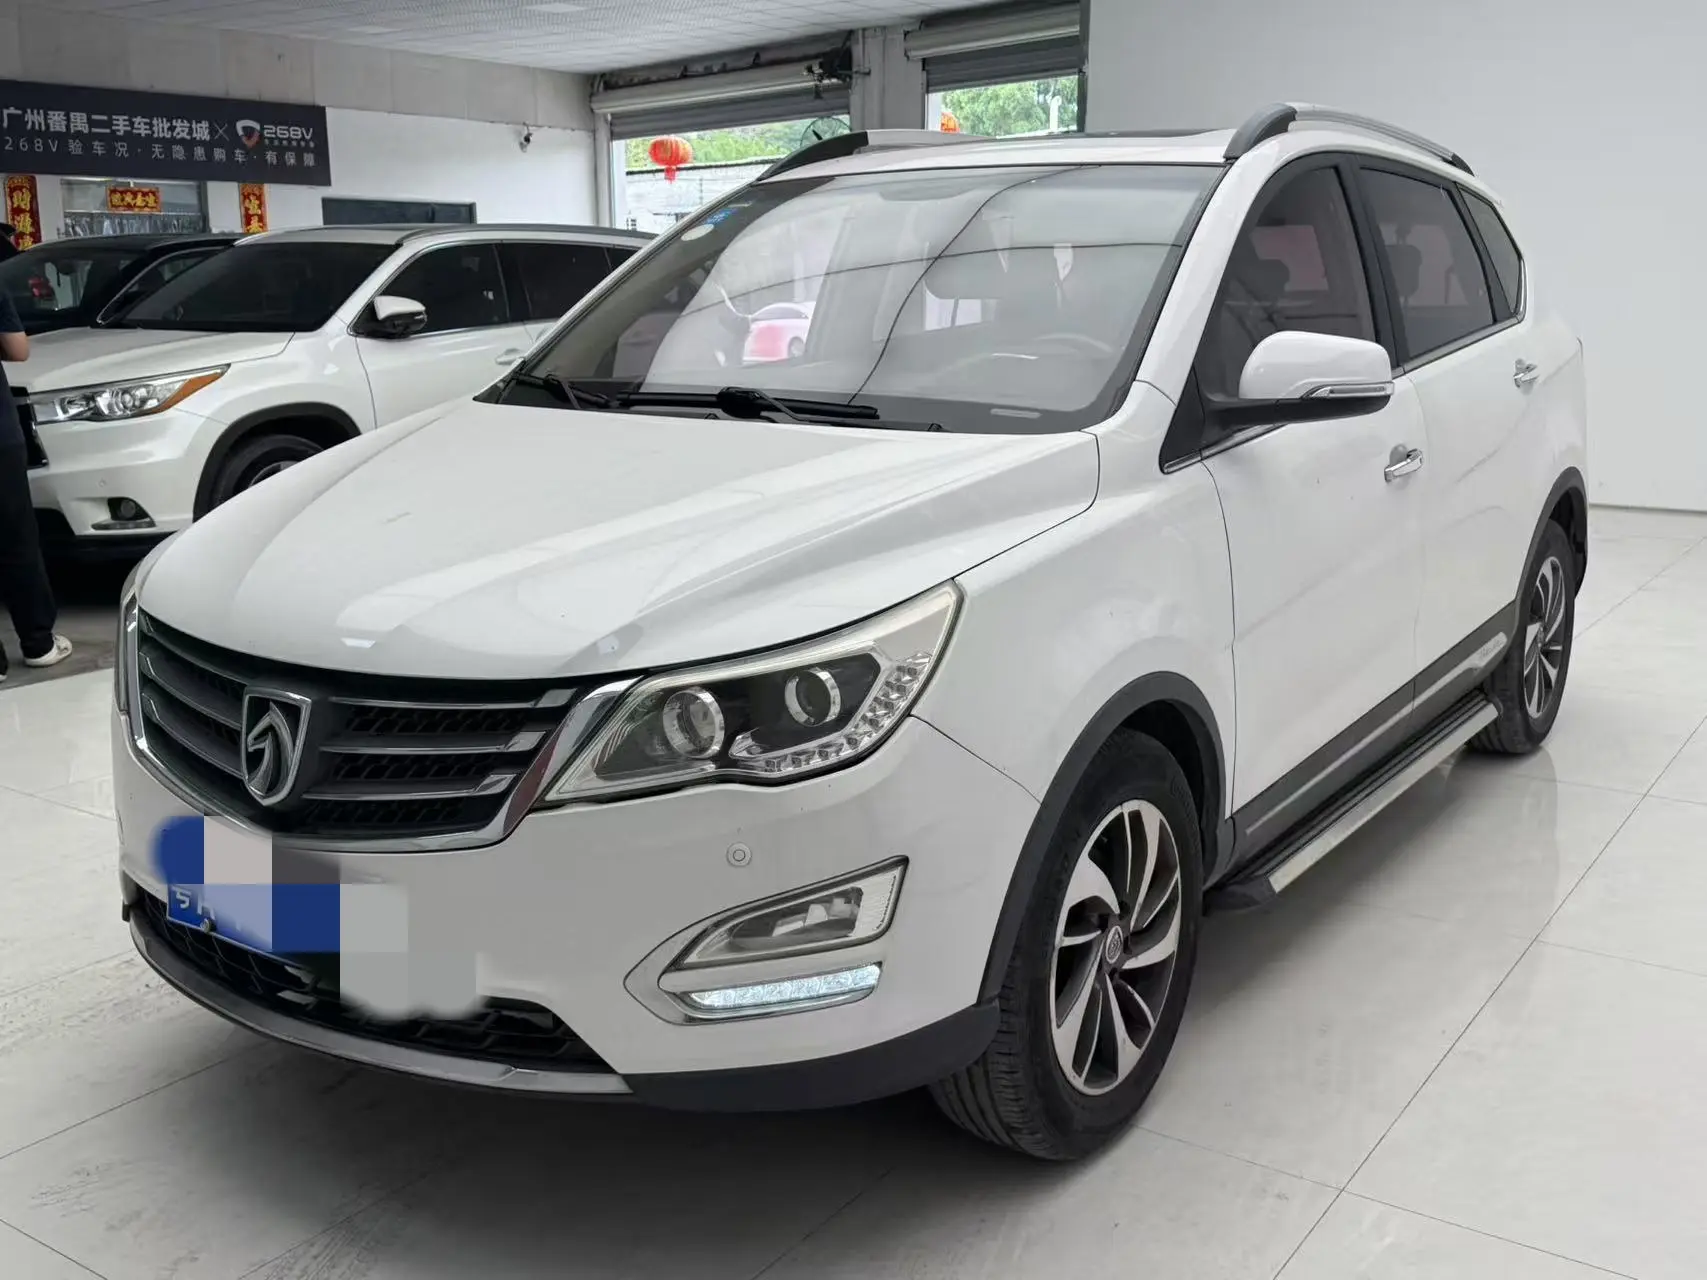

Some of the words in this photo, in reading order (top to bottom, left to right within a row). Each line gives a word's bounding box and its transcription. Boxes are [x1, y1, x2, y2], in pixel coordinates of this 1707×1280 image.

[2, 106, 211, 141] 广州番禺二手车批发城
[263, 124, 314, 140] 268V
